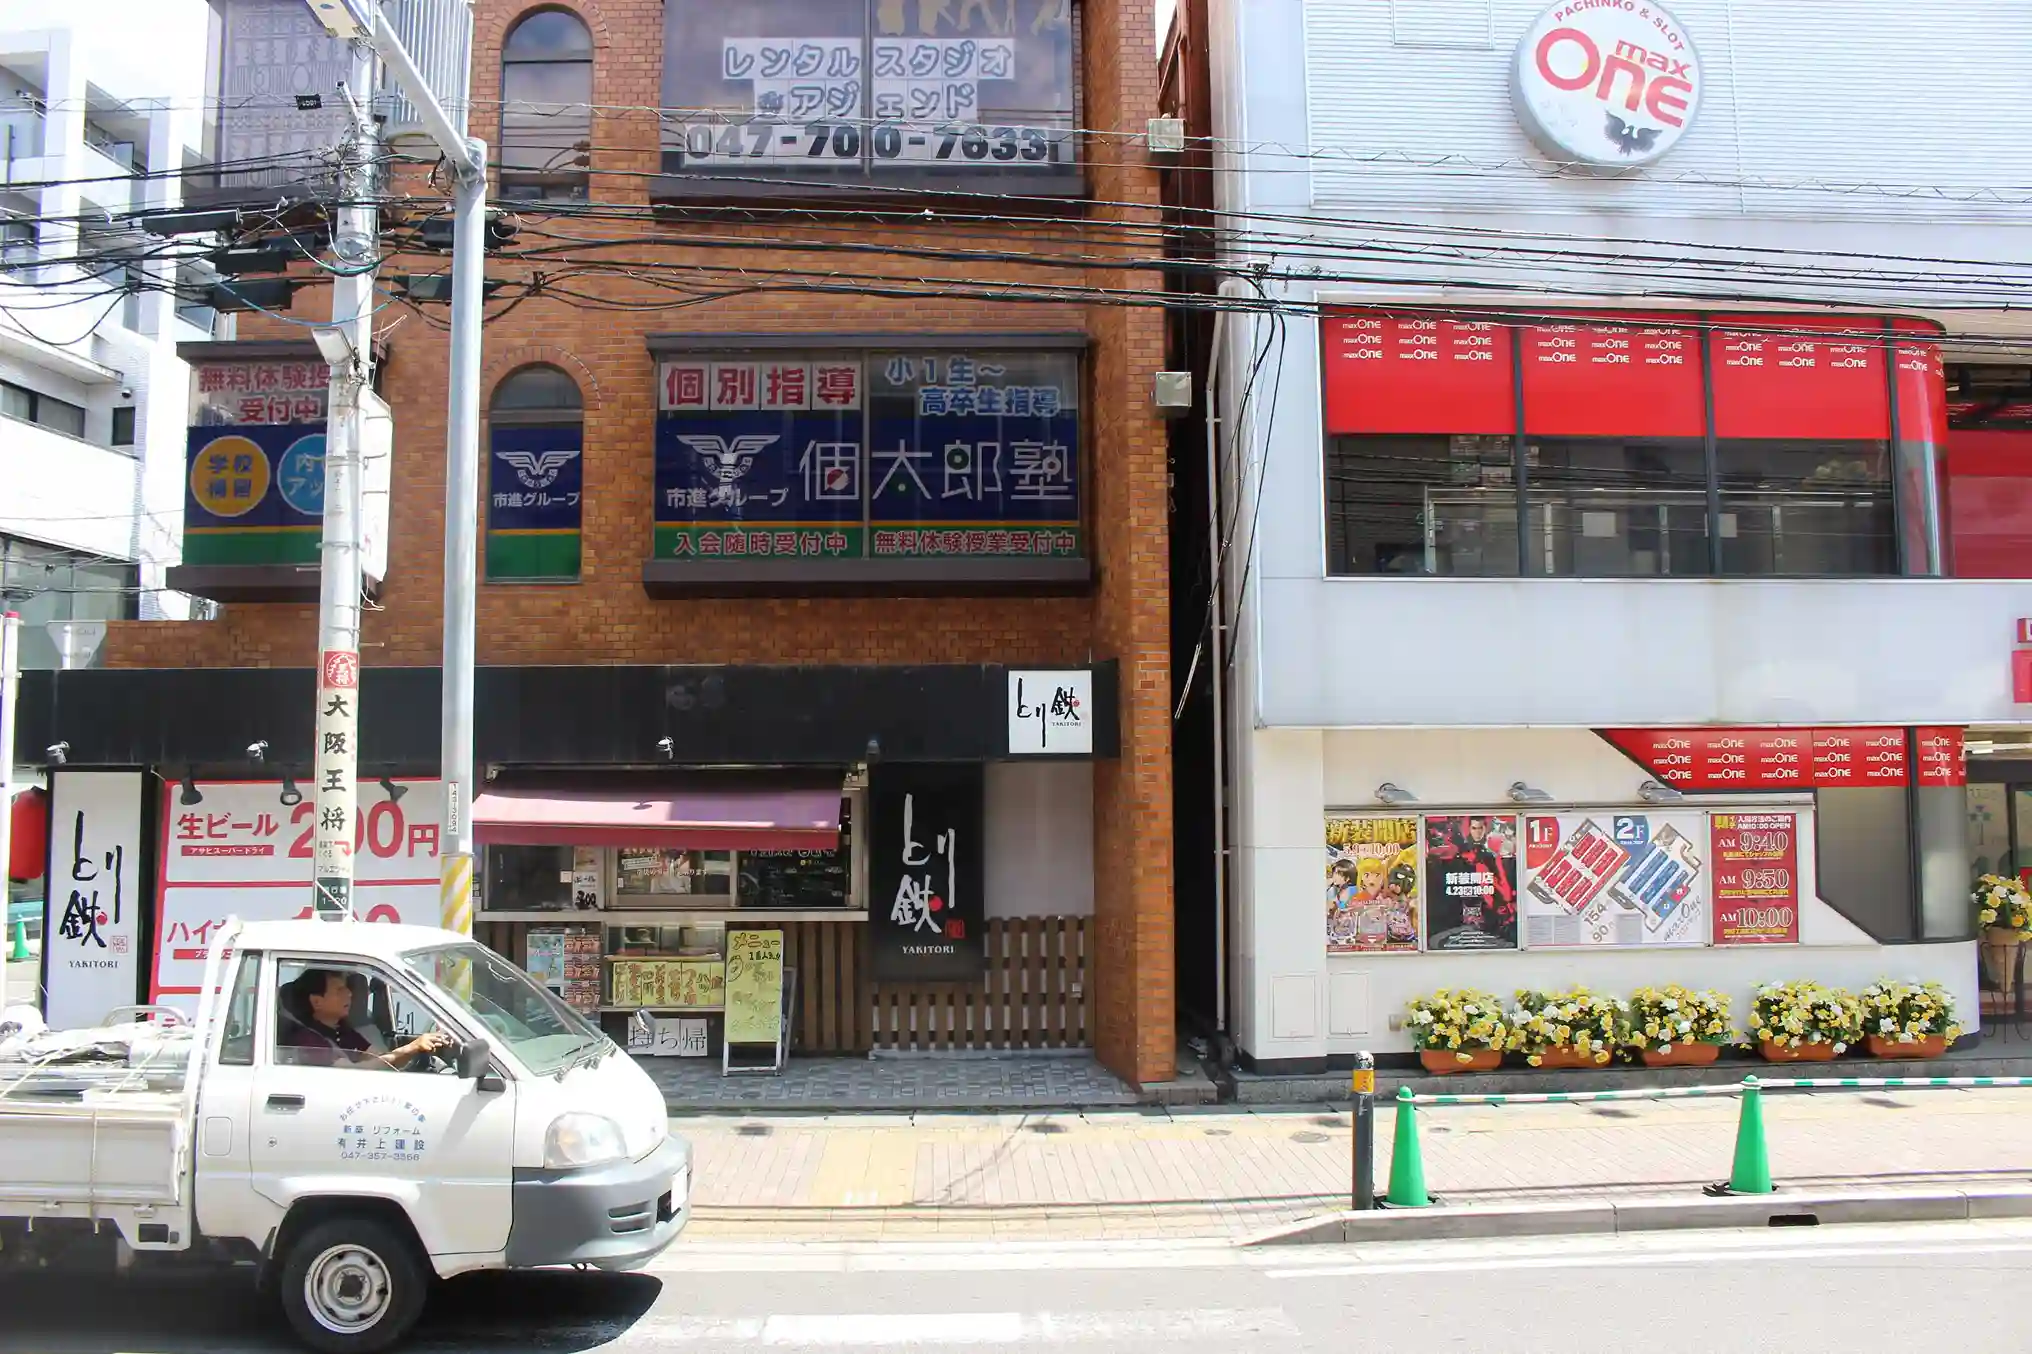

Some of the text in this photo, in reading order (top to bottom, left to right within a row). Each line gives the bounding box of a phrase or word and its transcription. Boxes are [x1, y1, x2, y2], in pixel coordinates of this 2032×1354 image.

[1555, 0, 1685, 51] PACHINKO & SLOT
[1615, 40, 1692, 79] max
[667, 367, 856, 405] 個別指導
[239, 397, 320, 422] 受付中
[919, 387, 1060, 416] 高卒生指導
[800, 440, 1073, 501] 個太郎塾
[493, 491, 579, 508] 市進グループ
[667, 487, 789, 508] 市進グループ
[674, 532, 848, 556] 入会随時受付中
[874, 532, 1076, 556] 無料体験授業受付中
[320, 695, 351, 832] 大阪王将
[177, 813, 279, 839] 生ビール
[1616, 817, 1645, 840] 2F
[190, 847, 265, 855] アサヒスーパードライ
[1718, 831, 1788, 852] AM 9:40
[1445, 872, 1494, 884] 新装開店
[1719, 868, 1790, 889] AM 9:50
[1720, 907, 1793, 928] AM 10:00
[902, 945, 954, 954] YAKITORI
[69, 960, 118, 969] YAKITORI
[373, 1126, 420, 1136] リフォーム
